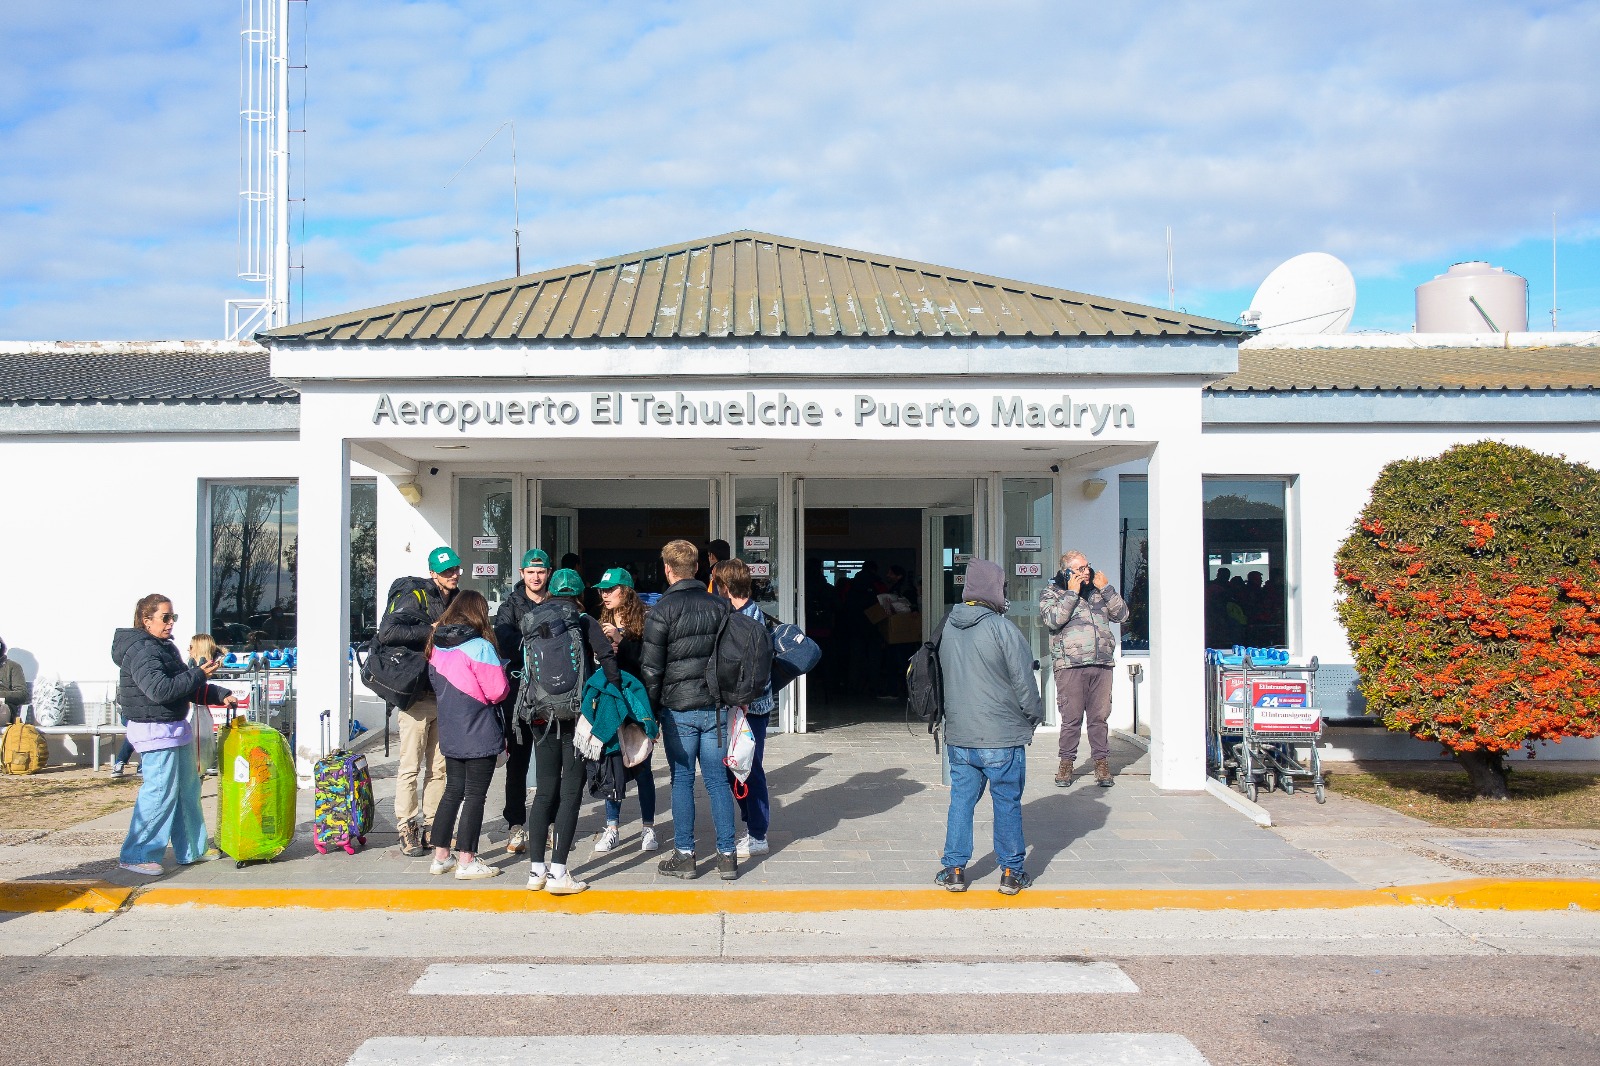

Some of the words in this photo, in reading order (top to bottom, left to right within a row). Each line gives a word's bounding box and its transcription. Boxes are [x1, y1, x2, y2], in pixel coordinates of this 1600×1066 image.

[372, 393, 578, 432] Aeropuerto
[590, 392, 622, 425] El
[631, 392, 823, 426] Tehuelche
[854, 394, 979, 427] Puerto
[990, 394, 1135, 436] Madryn
[1262, 697, 1278, 707] 24
